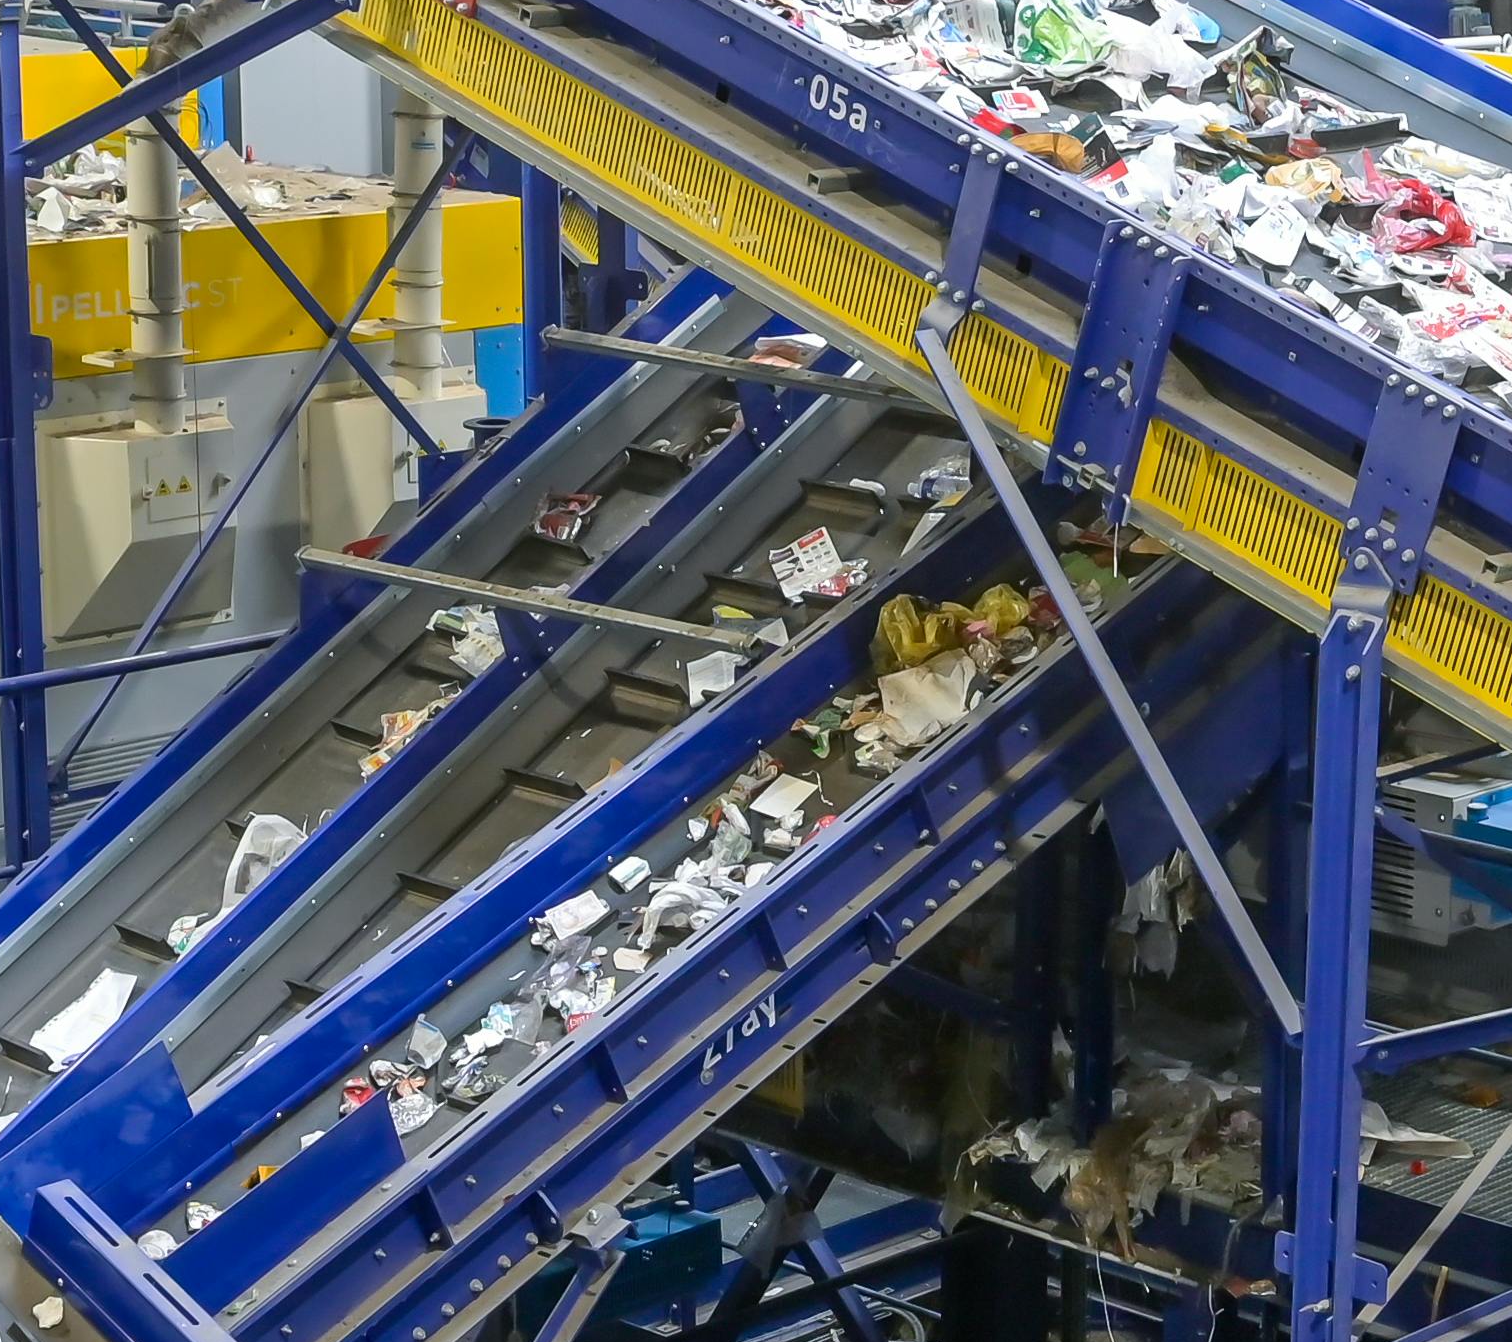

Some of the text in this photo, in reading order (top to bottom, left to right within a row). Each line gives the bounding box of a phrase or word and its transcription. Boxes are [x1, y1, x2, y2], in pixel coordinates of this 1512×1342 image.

[809, 74, 867, 133] 05a
[52, 277, 243, 323] PELLC ST
